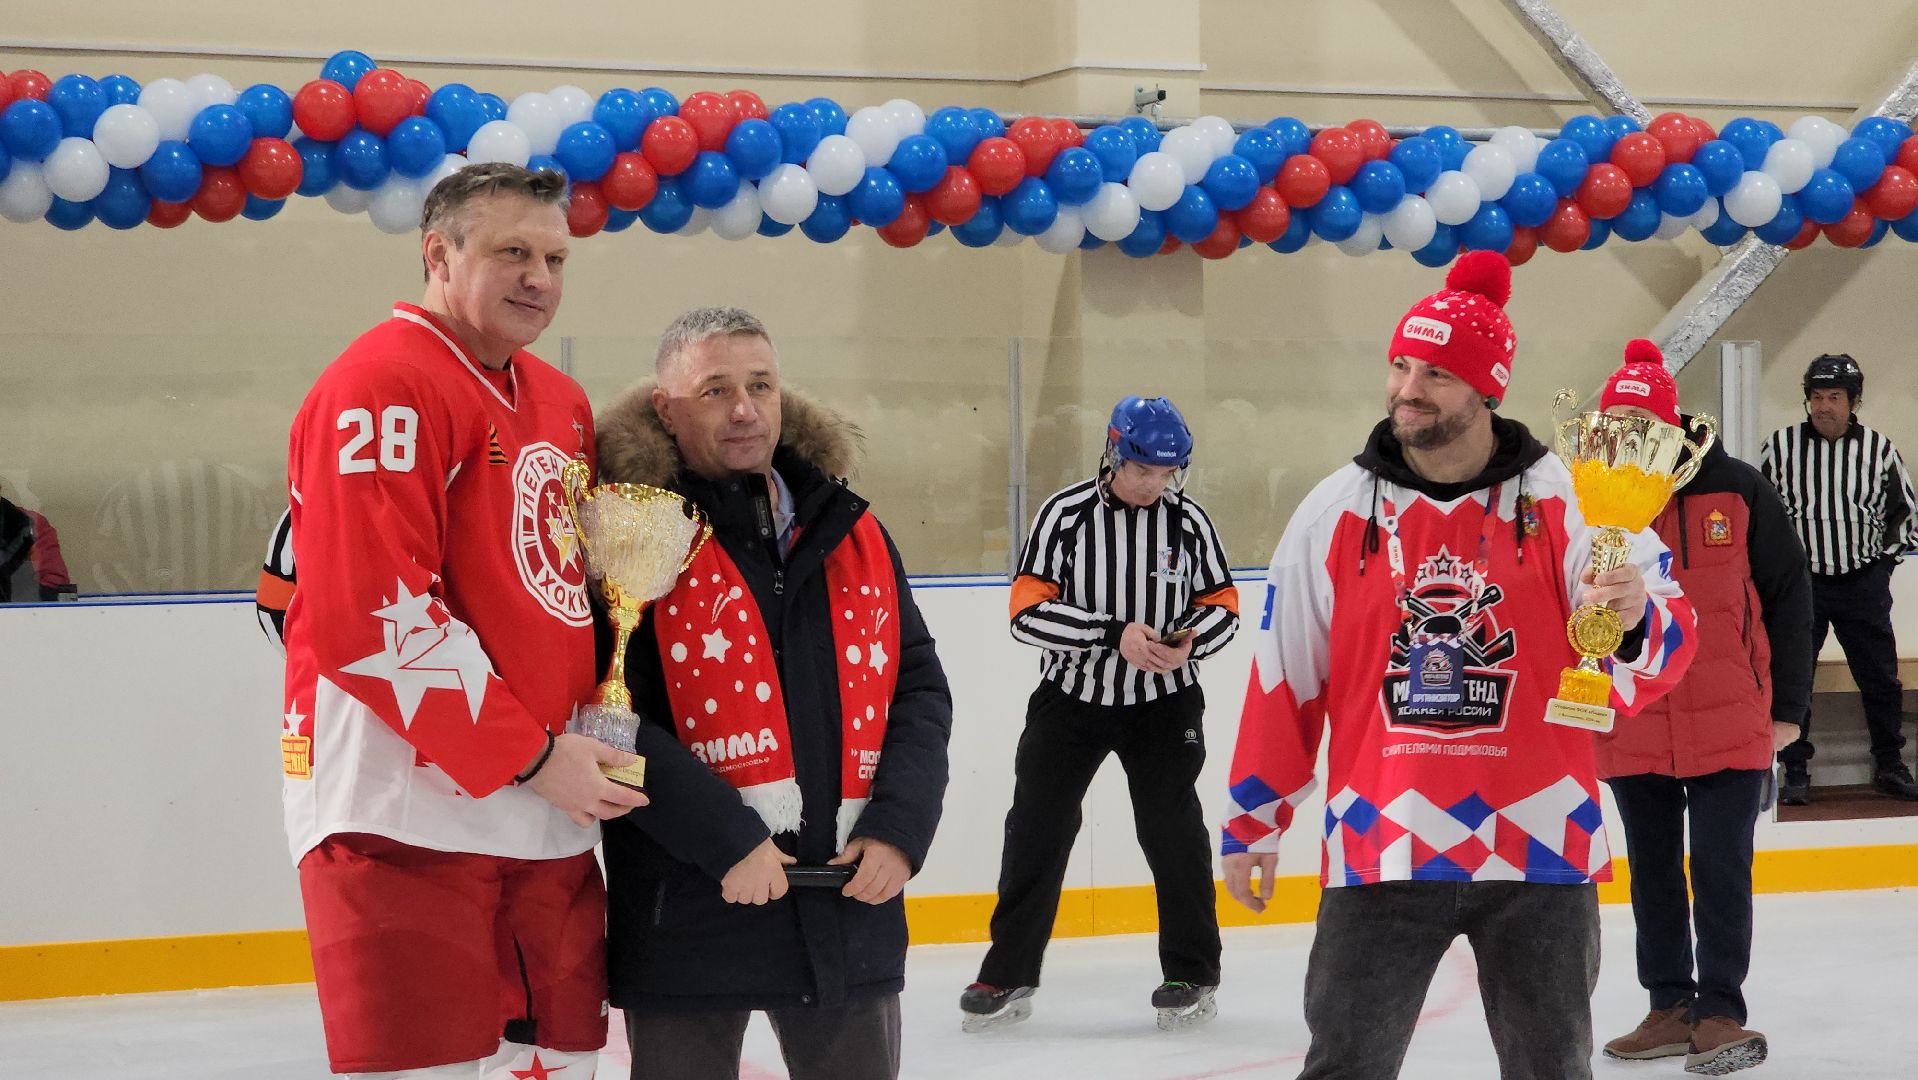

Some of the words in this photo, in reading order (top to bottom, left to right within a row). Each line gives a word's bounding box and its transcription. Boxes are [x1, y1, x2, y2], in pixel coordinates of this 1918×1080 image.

[1406, 323, 1445, 341] ЗИМА
[336, 405, 419, 475] 28
[522, 454, 562, 515] ЛЕГЕН
[690, 727, 779, 764] ЗИМА
